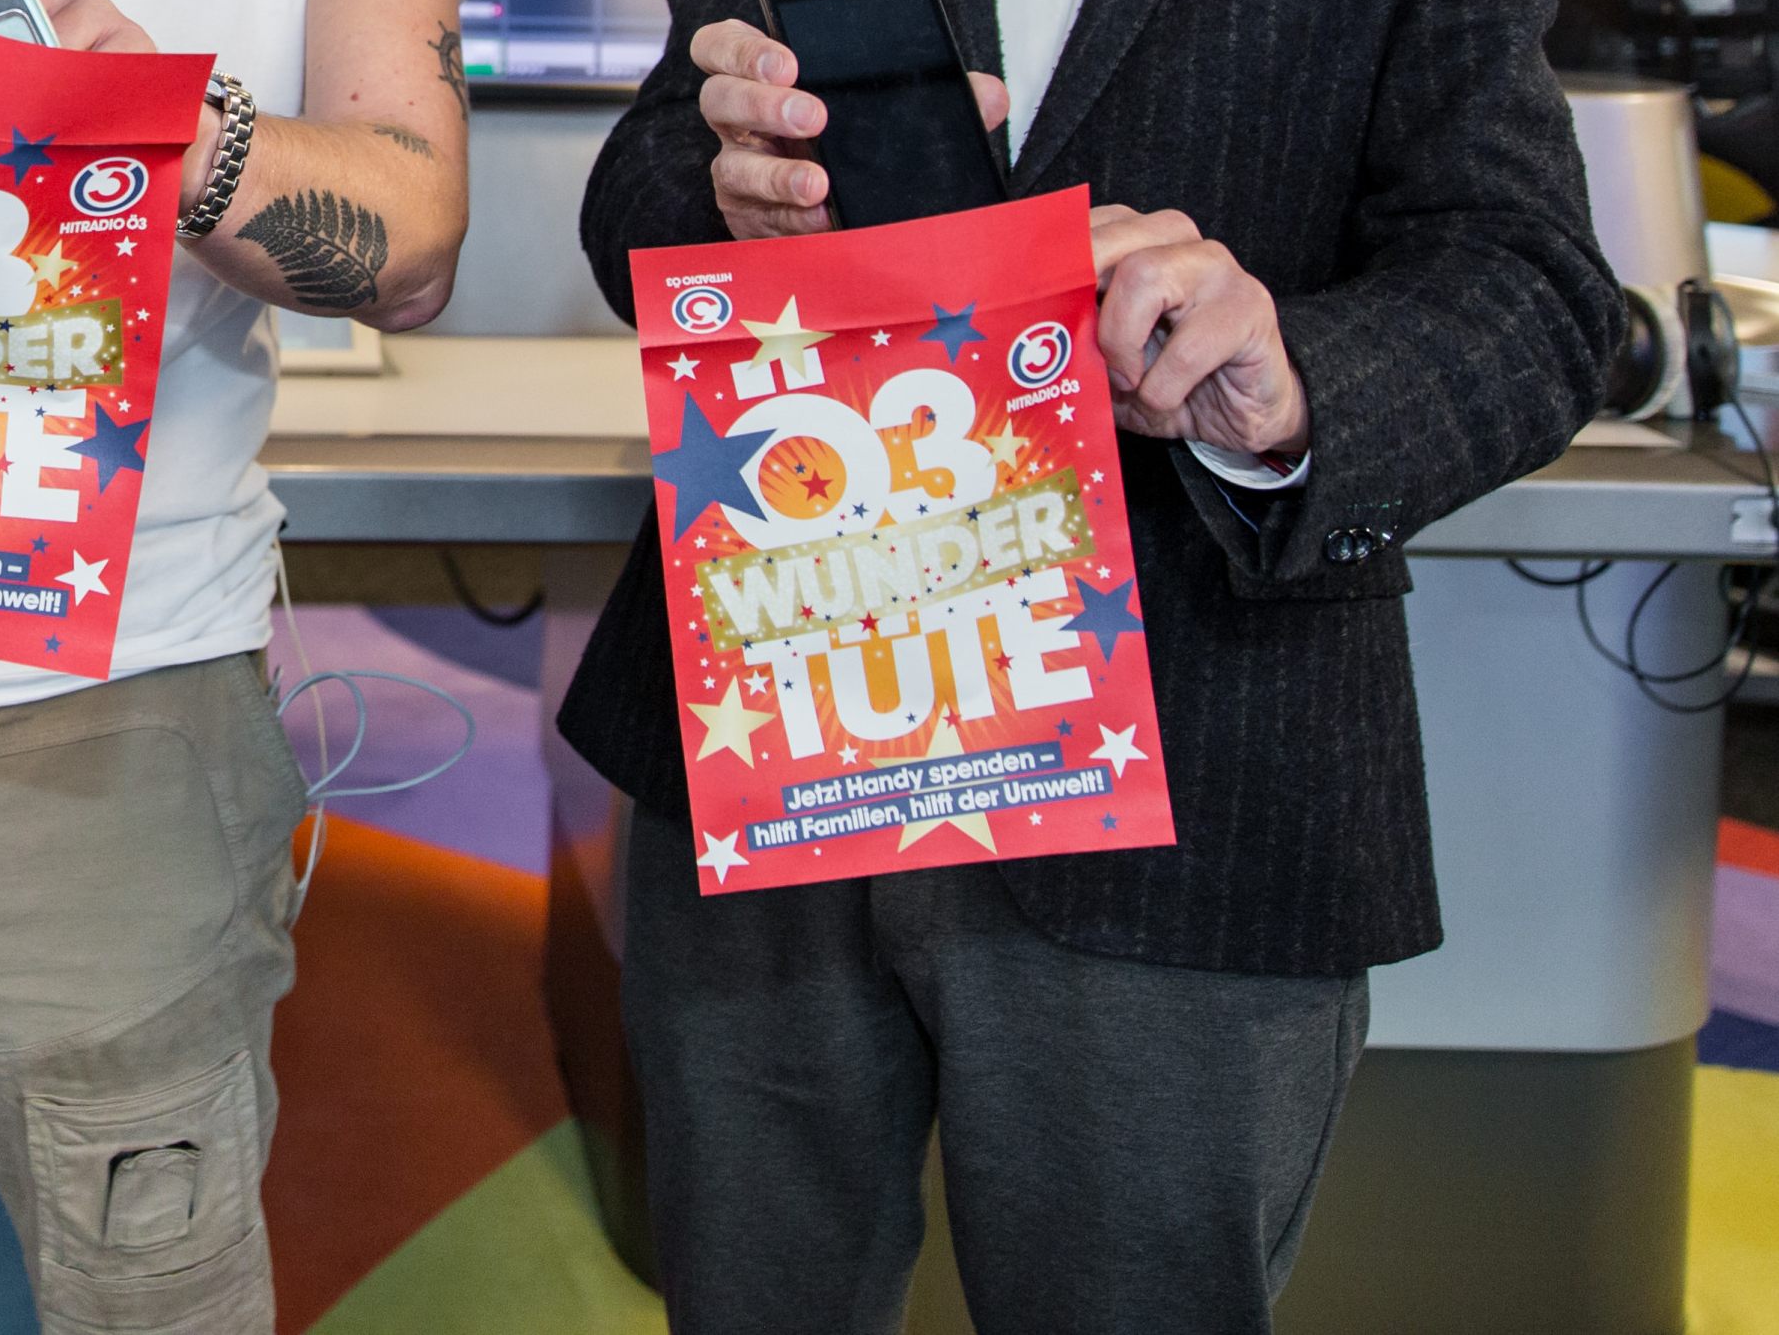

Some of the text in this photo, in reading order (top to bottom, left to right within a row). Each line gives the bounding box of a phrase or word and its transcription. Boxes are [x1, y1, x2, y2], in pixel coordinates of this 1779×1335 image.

[59, 213, 148, 234] HITRADIO Ö3
[1006, 378, 1080, 413] HITRADIO Ö3
[709, 490, 1076, 638] WUNDER
[743, 567, 1093, 760] TÜTE
[754, 770, 1104, 847] hilft Familien, hilft der Umwelt!
[788, 785, 842, 811] Jetzt
[846, 767, 922, 800] Handy
[929, 750, 1035, 789] spenden
